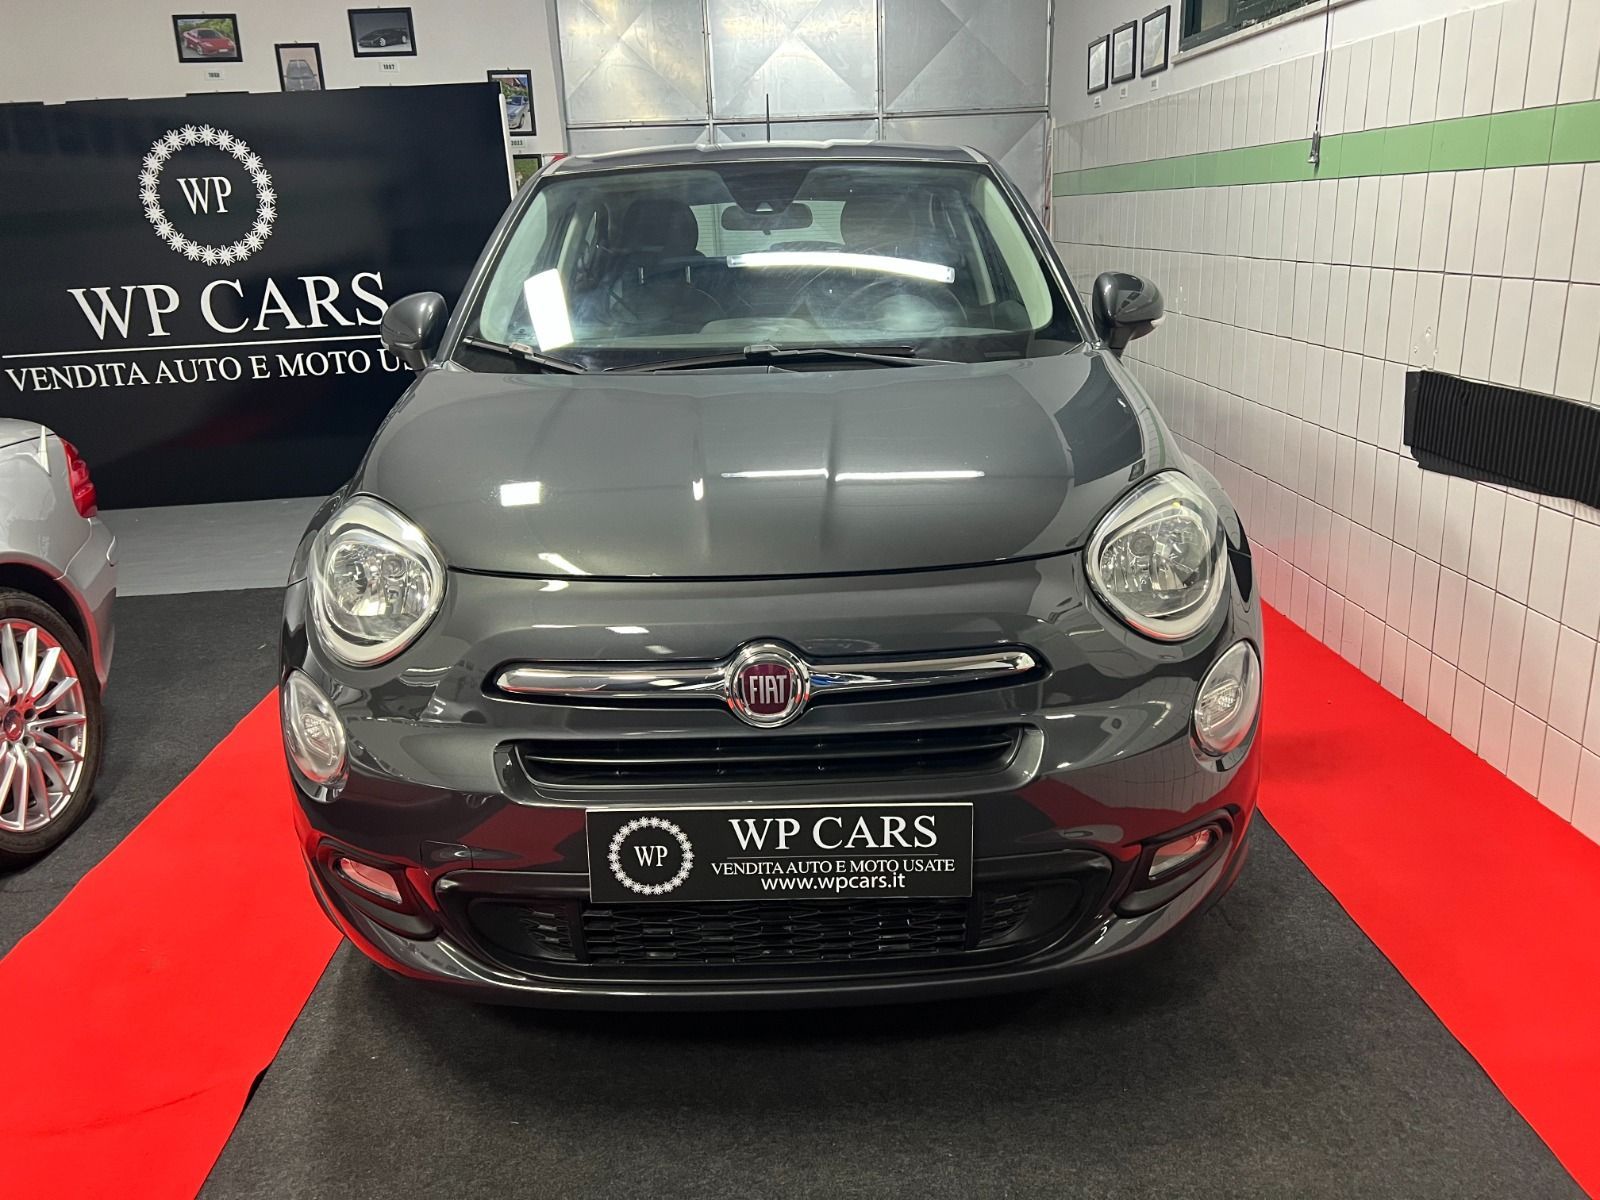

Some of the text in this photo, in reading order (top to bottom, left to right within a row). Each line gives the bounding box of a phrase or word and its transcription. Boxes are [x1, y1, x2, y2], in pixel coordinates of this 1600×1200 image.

[176, 176, 232, 214] WP
[67, 271, 389, 340] WP CARS
[4, 362, 151, 392] VENDITA
[155, 356, 242, 384] AUTO
[250, 355, 271, 379] E
[275, 349, 371, 378] MOTO
[749, 675, 787, 704] FIAT
[727, 815, 938, 850] WP CARS
[633, 845, 668, 867] WP
[711, 858, 956, 876] VENDITA AUTO E MOTO USATE
[761, 871, 906, 893] www.wpcars.it
